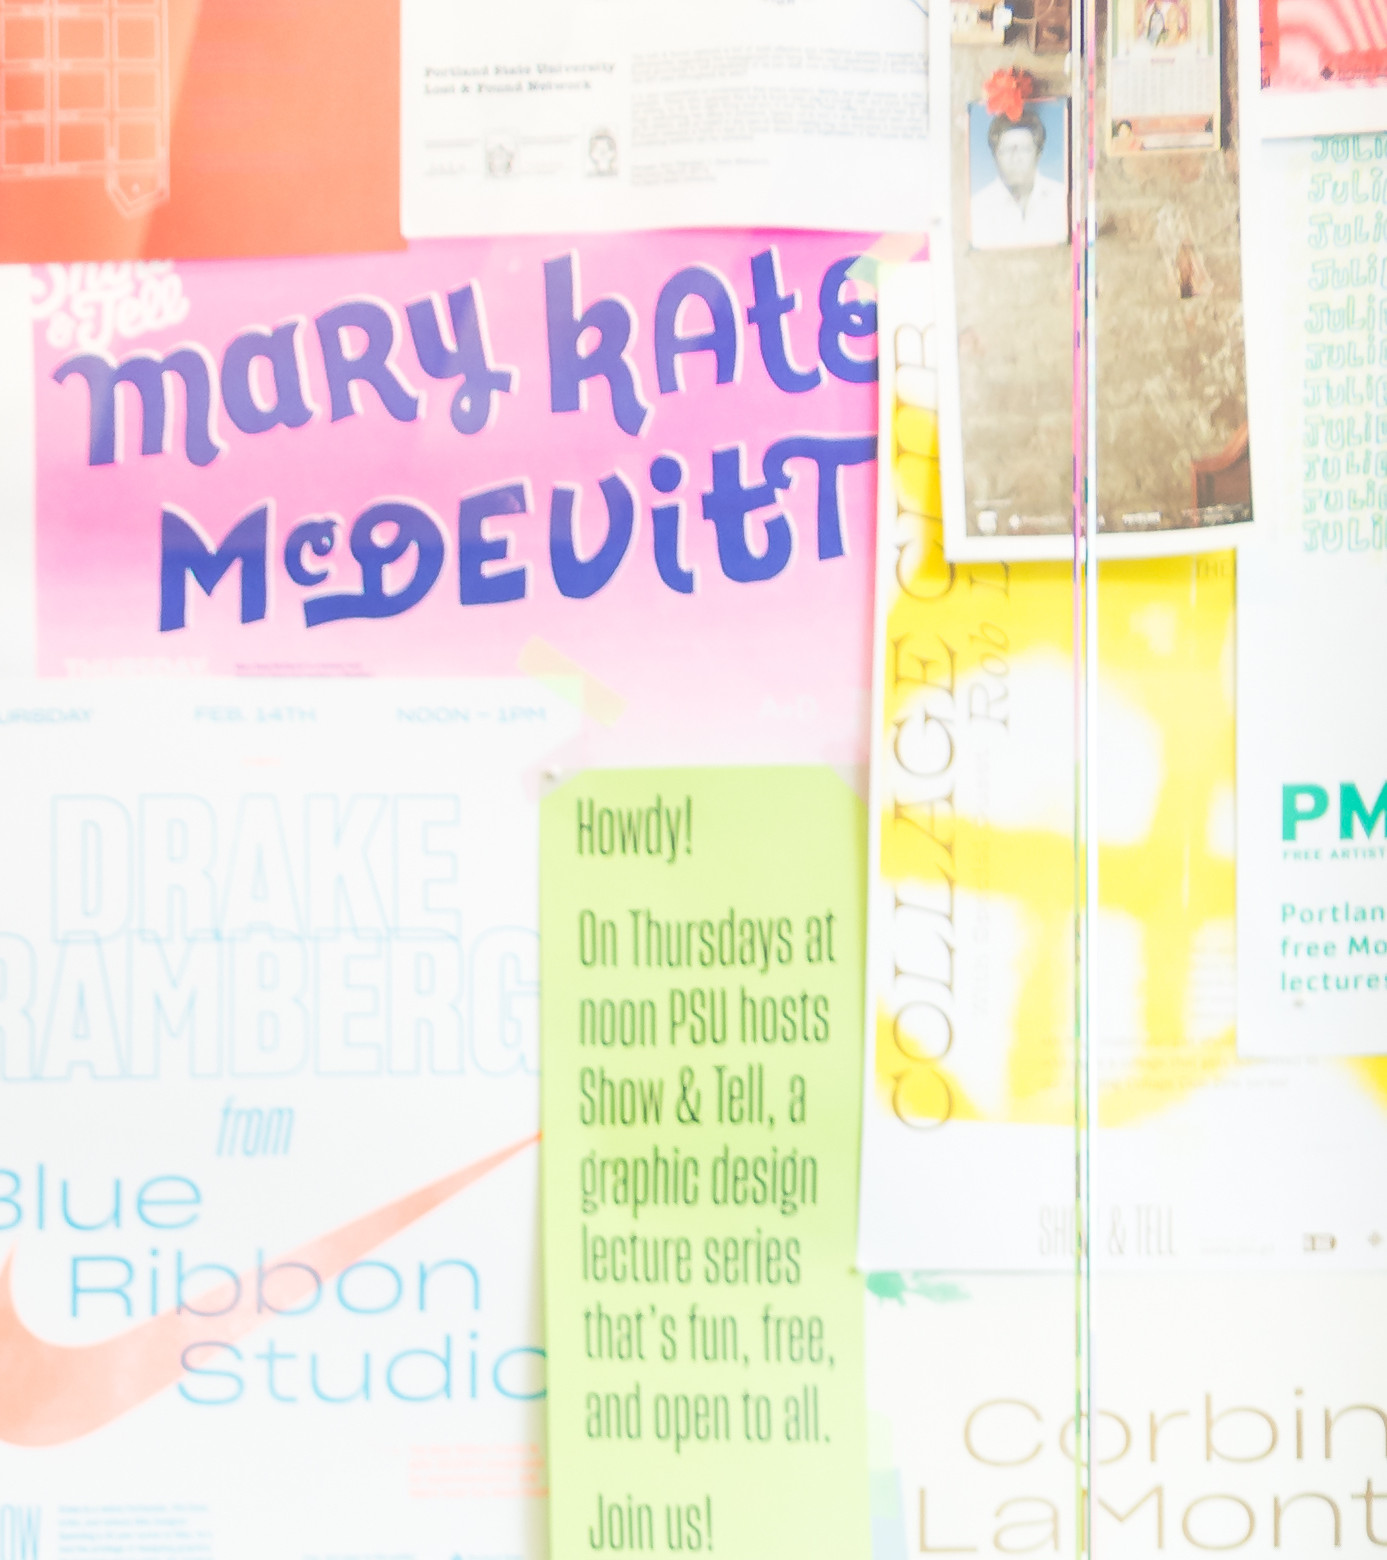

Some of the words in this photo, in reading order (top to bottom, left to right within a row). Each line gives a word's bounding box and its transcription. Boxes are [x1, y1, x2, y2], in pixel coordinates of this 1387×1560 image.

[576, 797, 694, 865] Howdy!
[891, 633, 957, 1131] COLLAGE
[578, 908, 619, 969] On
[630, 907, 794, 974] Thursdays
[805, 911, 837, 965] at
[578, 997, 658, 1048] noon
[670, 988, 728, 1046] PSU
[739, 987, 830, 1045] hosts
[578, 1066, 663, 1128] Show
[675, 1066, 701, 1126] &
[713, 1064, 776, 1130] Tell,
[788, 1073, 807, 1125] a
[580, 1146, 699, 1218] graphic
[711, 1146, 818, 1219] design
[69, 1247, 482, 1320] Ribbon
[581, 1223, 692, 1285] lecture
[702, 1230, 801, 1285] series
[583, 1303, 678, 1364] that's
[689, 1303, 751, 1370] fun,
[761, 1303, 836, 1371] free,
[585, 1385, 642, 1443] and
[653, 1389, 730, 1455] open
[740, 1392, 773, 1443] to
[783, 1386, 832, 1444] all.
[590, 1493, 657, 1554] Join
[666, 1495, 715, 1552] us!
